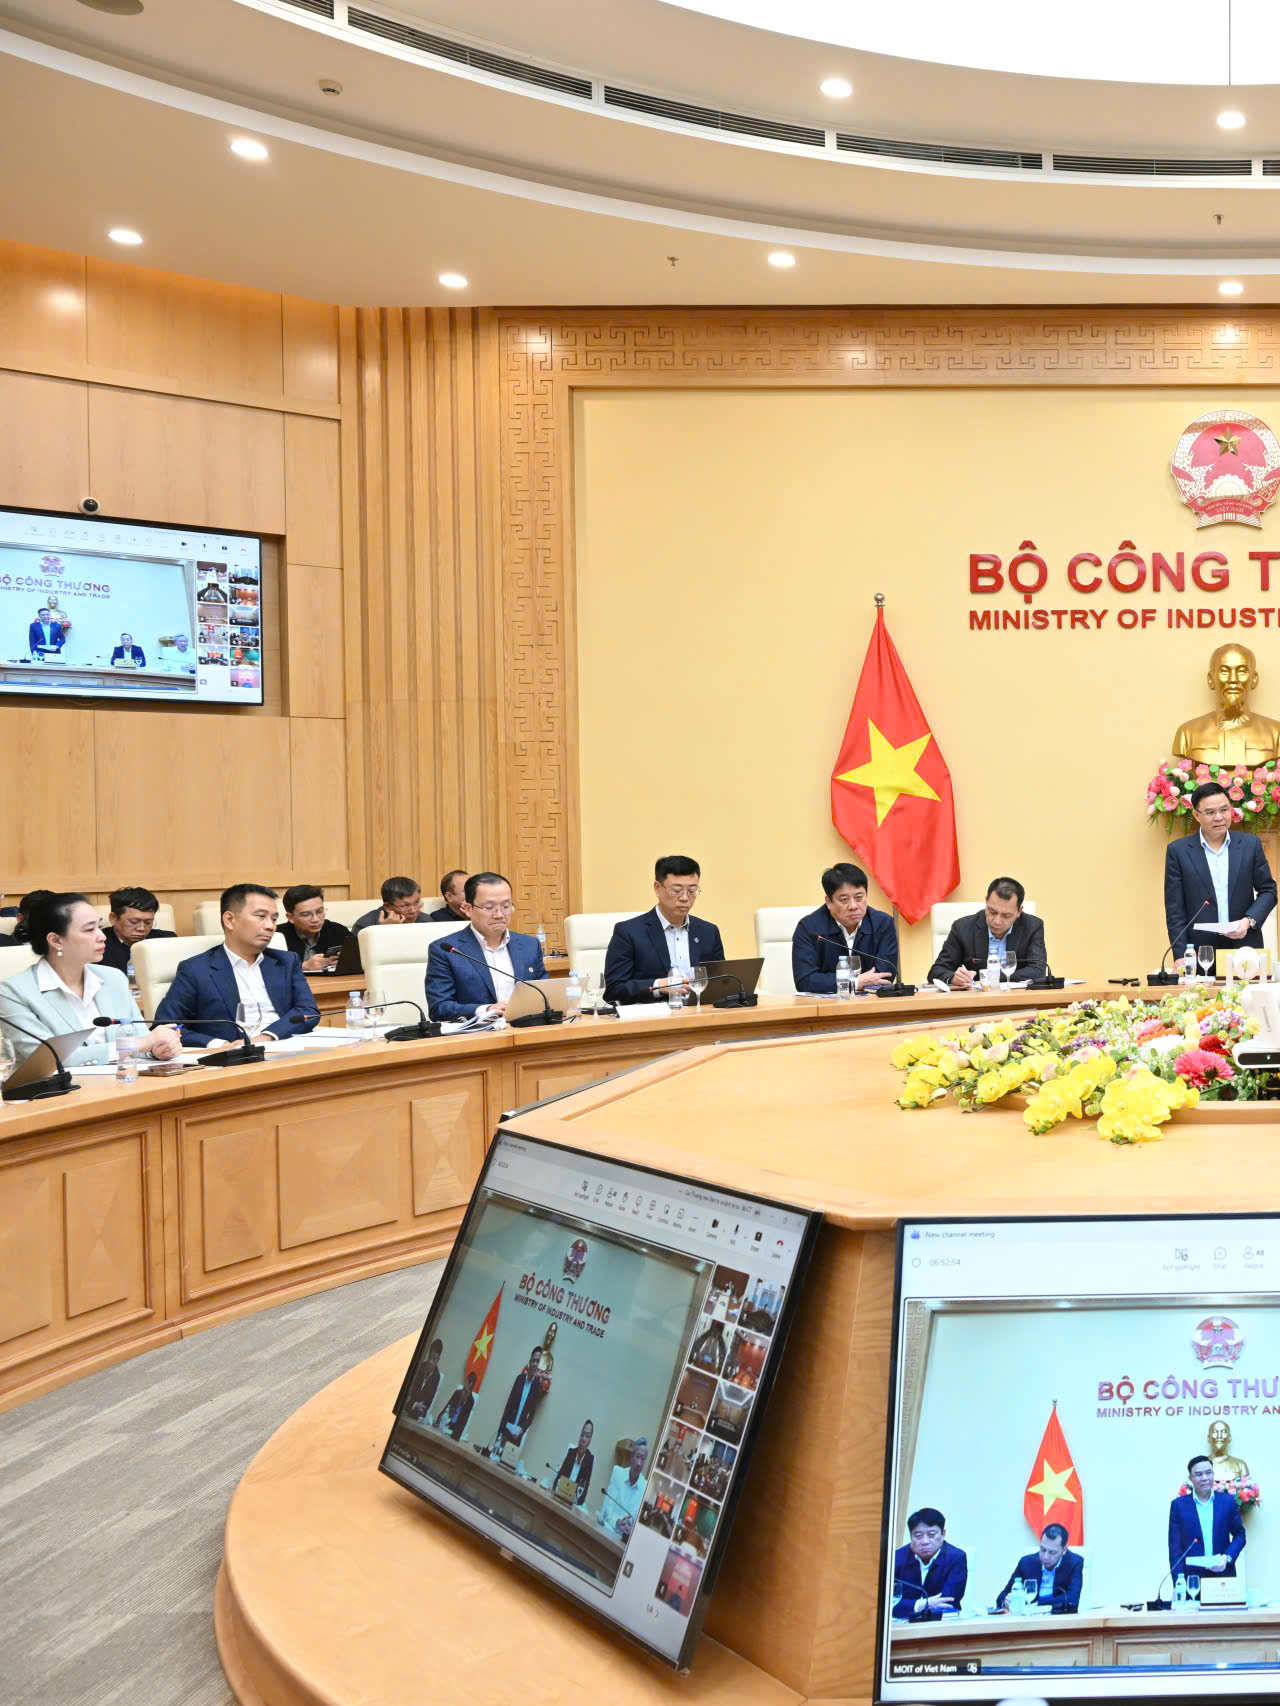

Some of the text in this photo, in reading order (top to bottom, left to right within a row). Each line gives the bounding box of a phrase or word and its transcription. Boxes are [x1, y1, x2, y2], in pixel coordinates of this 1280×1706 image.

[969, 540, 1048, 604] BỘ
[1067, 540, 1230, 593] CÔNG
[969, 608, 1108, 631] MINISTRY
[1116, 608, 1157, 630] OF
[519, 1272, 611, 1324] BỘ CÔNG THƯƠNG
[586, 1323, 605, 1338] TRADE
[1098, 1375, 1135, 1405] BỘ
[1143, 1374, 1218, 1400] CÔNG
[1097, 1407, 1162, 1418] MINISTRY
[1165, 1406, 1184, 1416] OF
[1189, 1405, 1258, 1416] INDUSTRY
[894, 1664, 957, 1674] MOIT of Viet Nam
